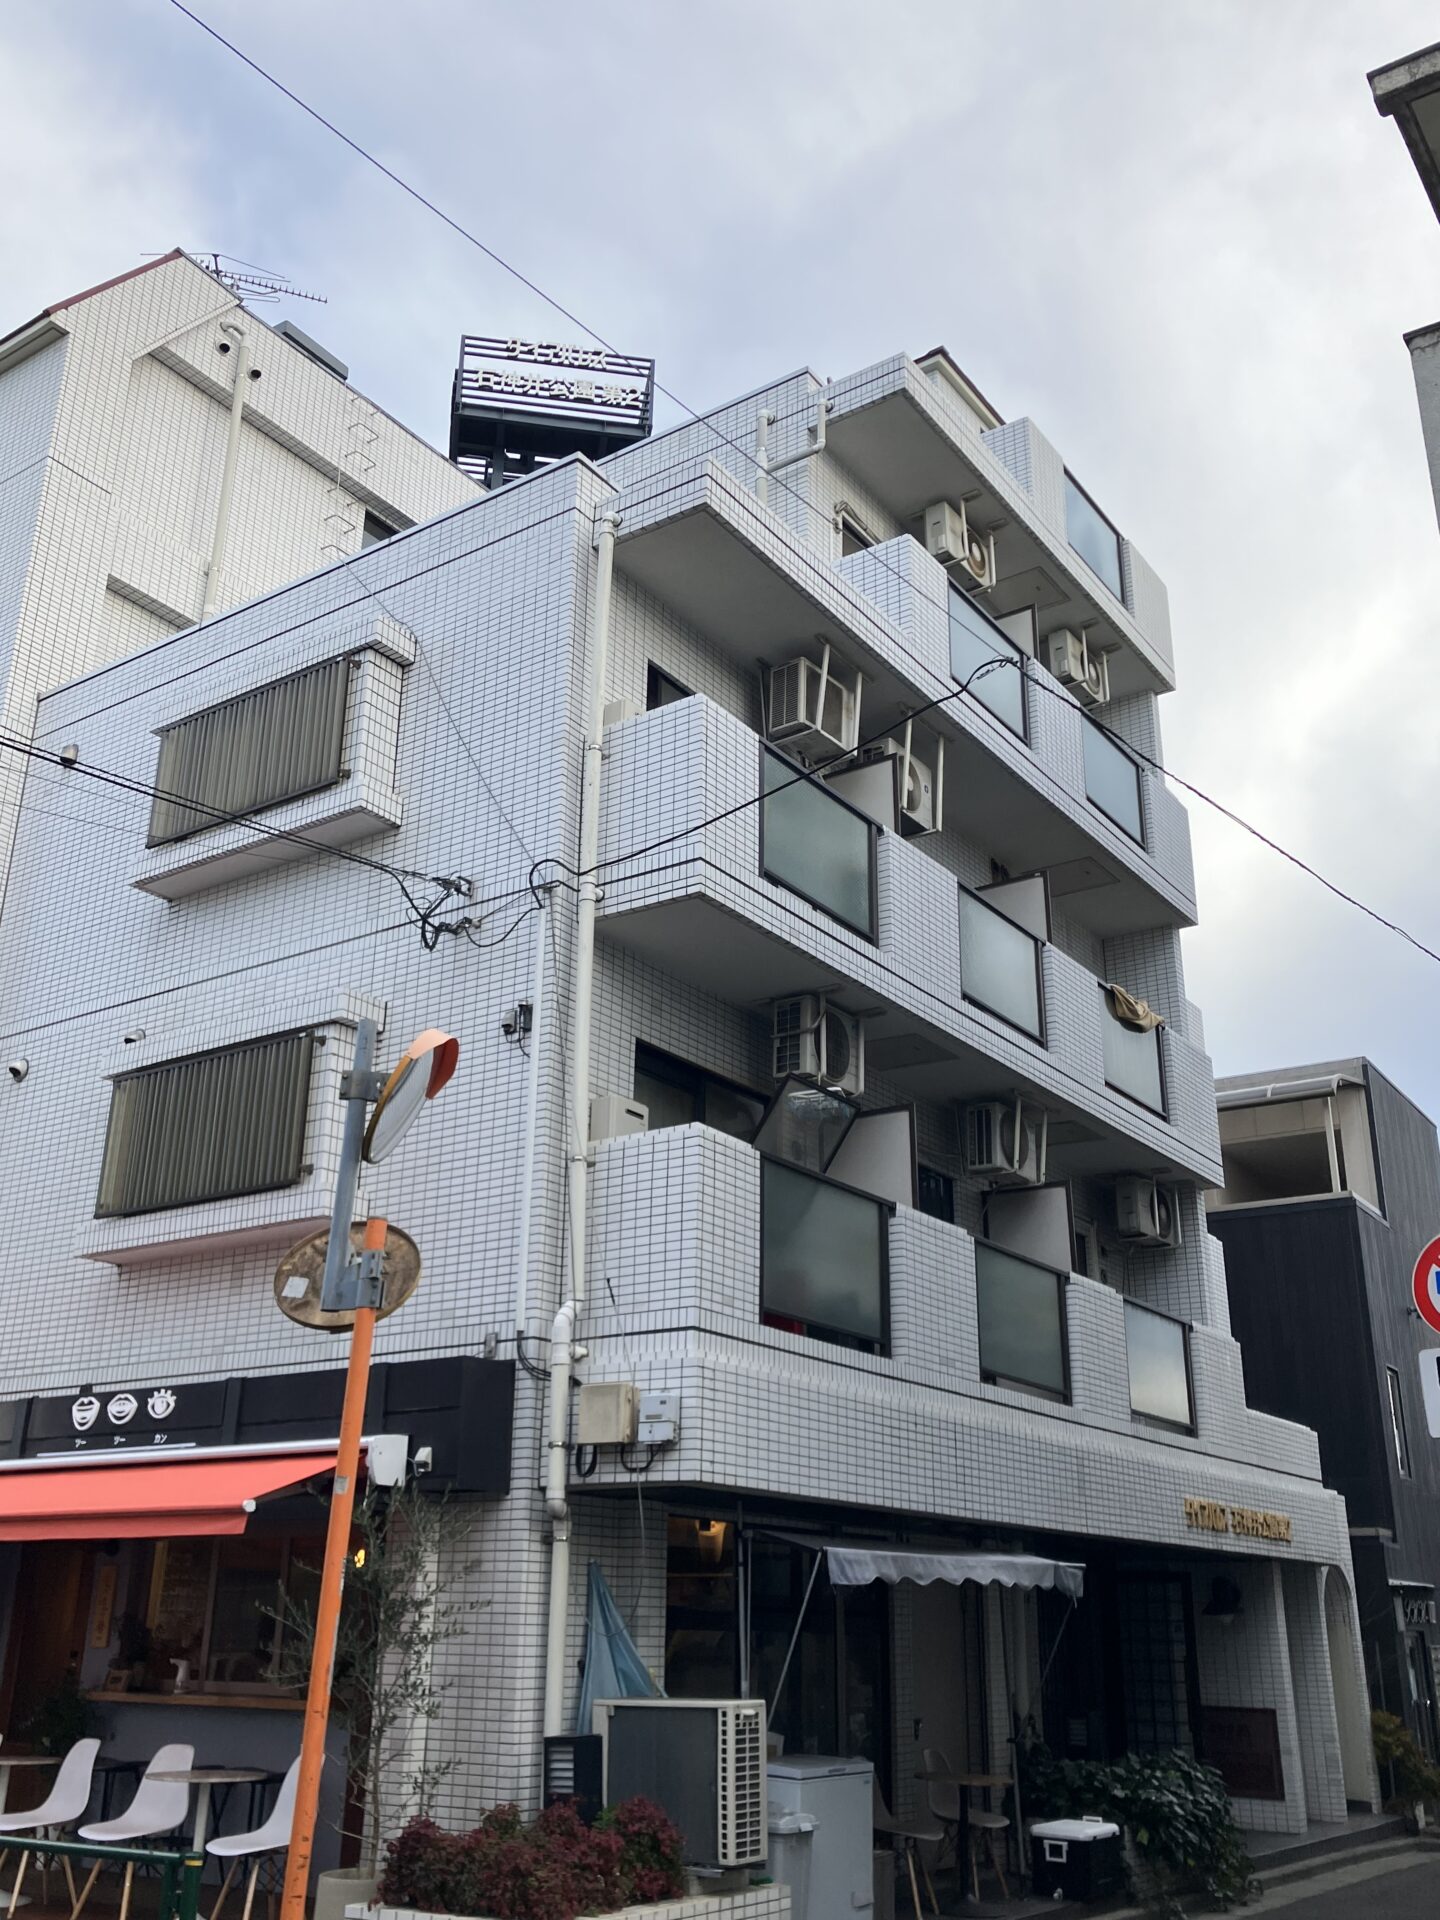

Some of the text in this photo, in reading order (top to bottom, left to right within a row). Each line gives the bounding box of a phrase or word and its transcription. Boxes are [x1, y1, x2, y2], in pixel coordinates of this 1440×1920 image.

[506, 337, 607, 369] ダイアパレス
